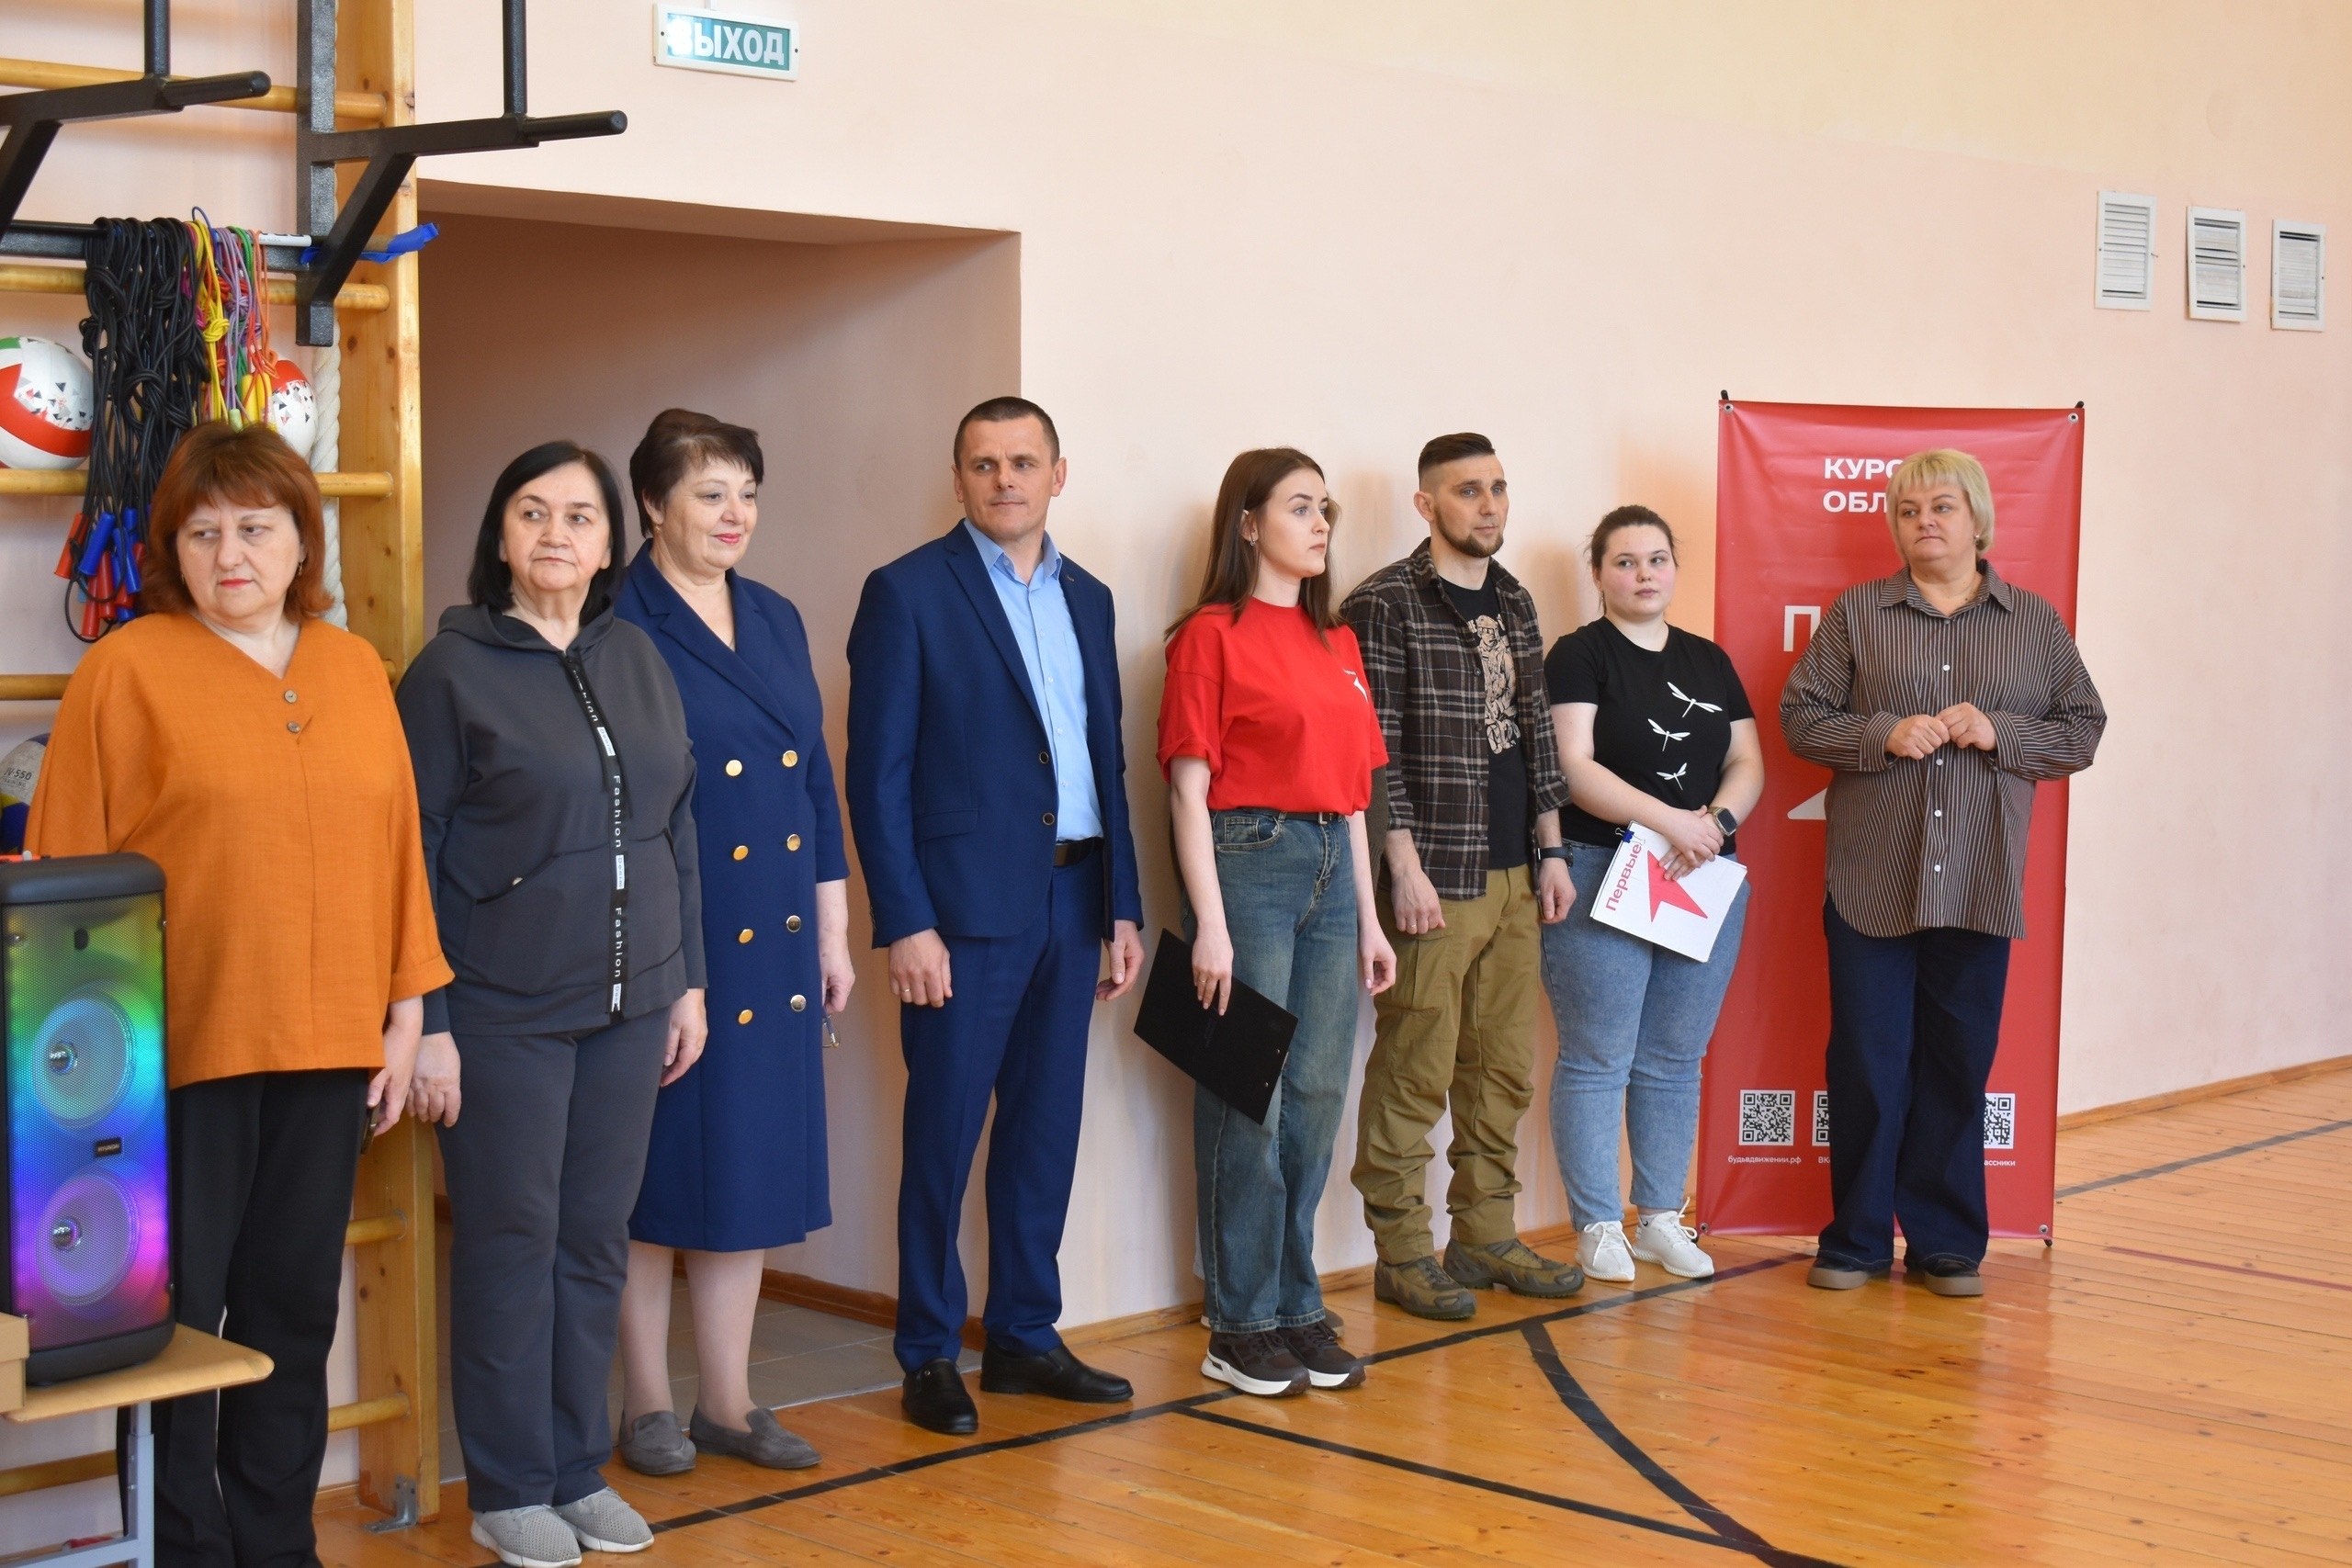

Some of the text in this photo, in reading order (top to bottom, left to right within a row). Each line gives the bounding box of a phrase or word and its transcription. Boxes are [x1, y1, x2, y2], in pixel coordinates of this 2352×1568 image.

[1824, 457, 1904, 480] КУРС
[1823, 491, 1887, 513] ОБЛ
[614, 774, 622, 848] Fashion
[1605, 843, 1643, 911] Первые
[615, 907, 623, 978] Fashion
[1727, 1155, 1802, 1165] будьвдвижении.рф
